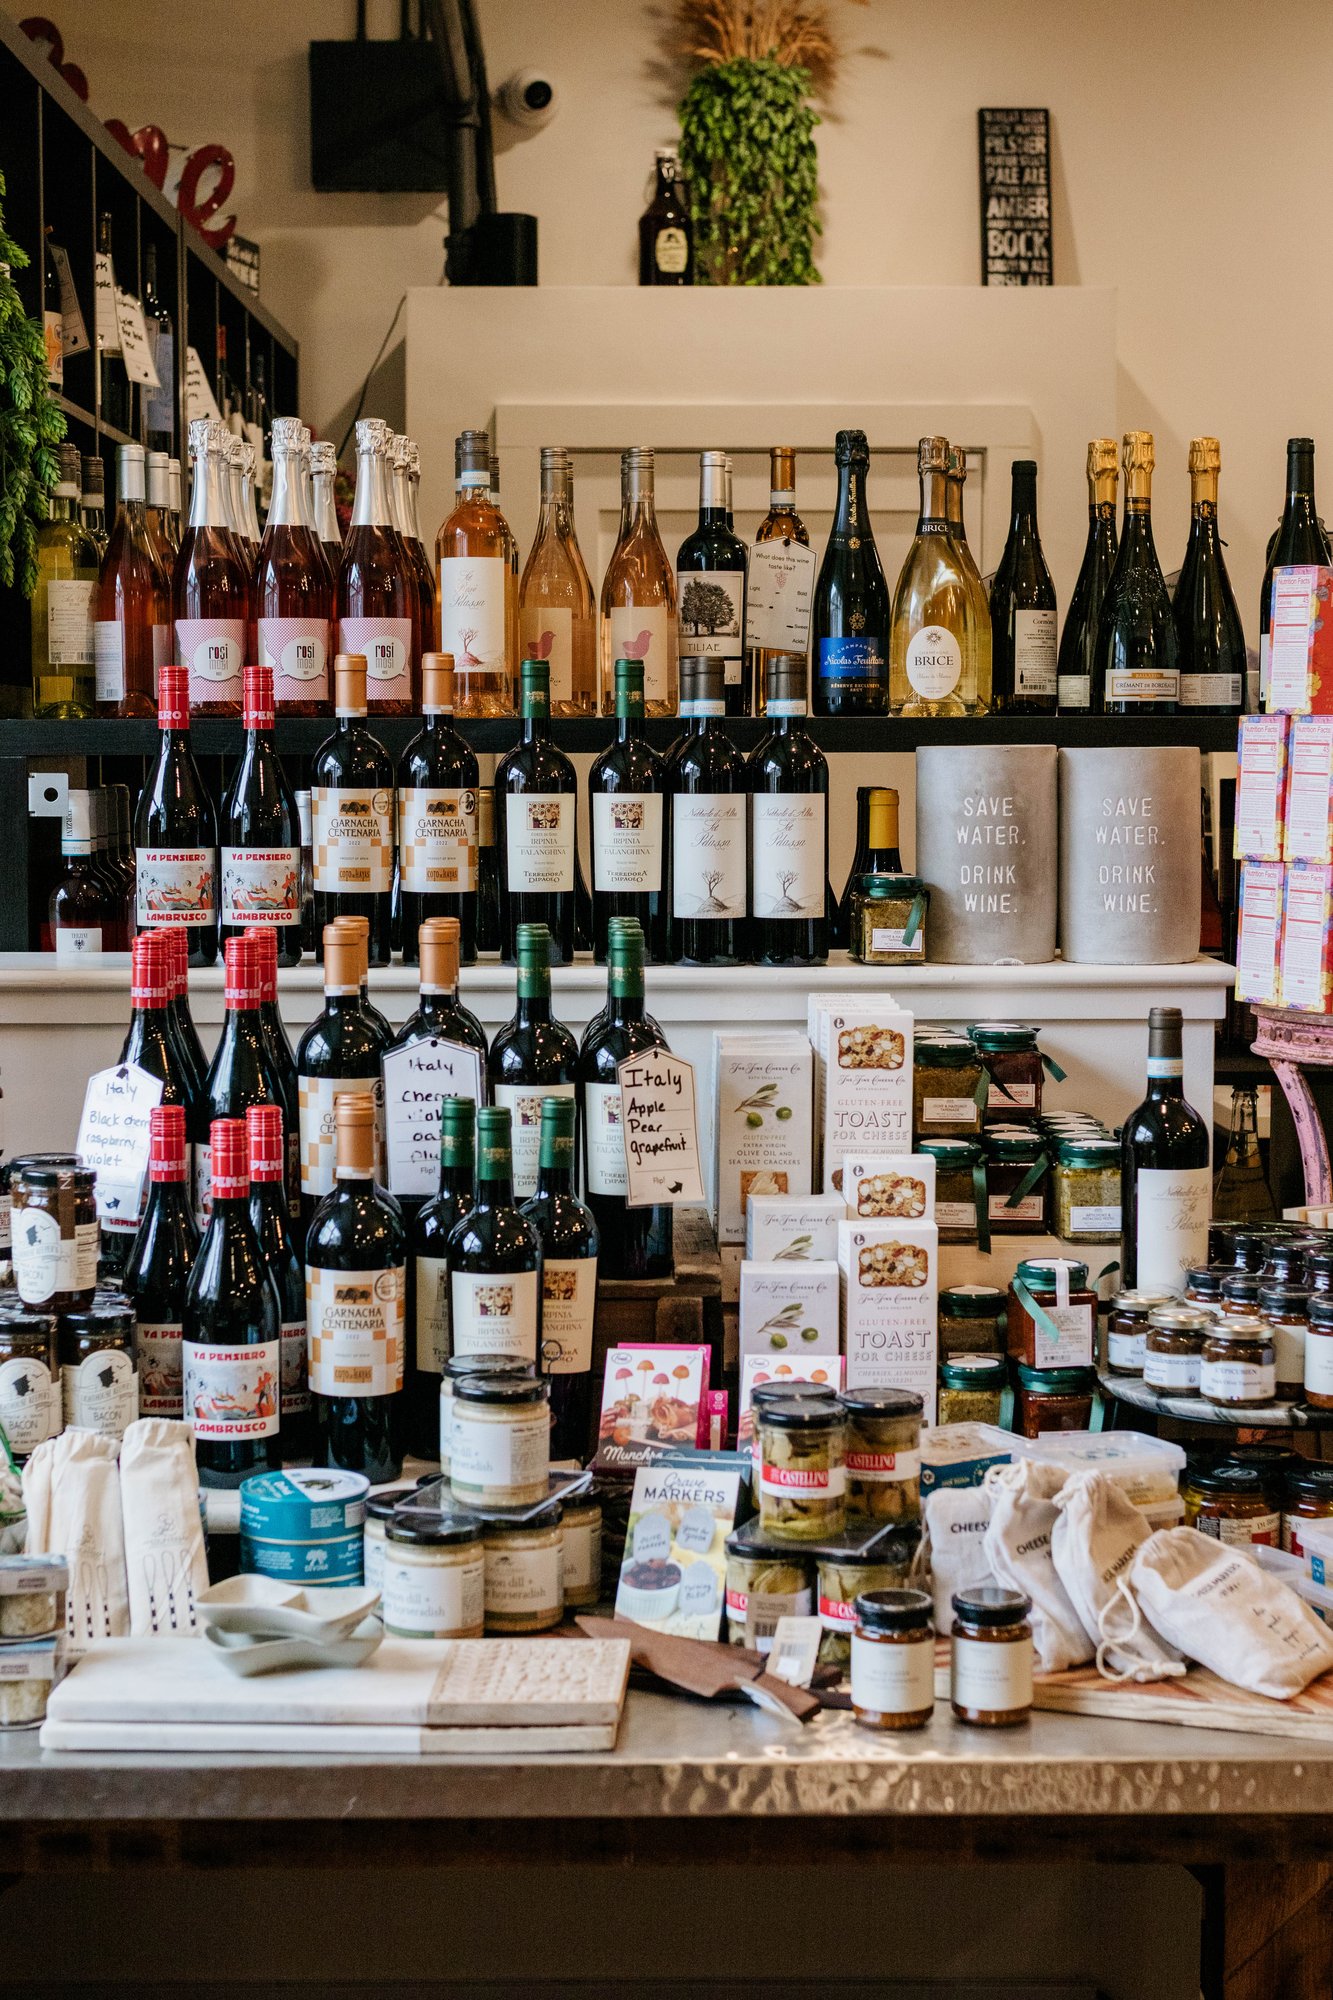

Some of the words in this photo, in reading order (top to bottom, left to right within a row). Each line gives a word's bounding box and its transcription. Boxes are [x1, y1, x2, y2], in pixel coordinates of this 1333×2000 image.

[986, 167, 1020, 185] PALE
[1022, 167, 1047, 185] ALE
[987, 197, 1049, 218] AMBER
[987, 230, 1049, 258] BOCK
[921, 524, 949, 532] BRICE
[296, 642, 315, 658] rosi
[375, 642, 394, 658] rosi
[914, 656, 954, 666] BRICE
[964, 797, 1014, 817] SAVE
[1102, 797, 1152, 817] SAVE
[330, 818, 379, 828] GARNACHA
[418, 818, 465, 828] GARNACHA
[328, 828, 382, 838] CENTENARIA
[415, 828, 468, 838] CENTENARIA
[956, 826, 1026, 845] WATER.
[1096, 826, 1166, 846] WATER.
[146, 854, 157, 862] VA
[160, 854, 206, 862] PENSIERO
[246, 853, 292, 861] PENSIERO
[520, 848, 566, 856] FALANGHINA
[604, 848, 650, 856] FALANGHINA
[523, 870, 564, 878] TERREDORA
[960, 865, 1017, 886] DRINK
[1099, 864, 1156, 886] DRINK
[1246, 870, 1264, 878] Nutrition
[964, 893, 1018, 914] WINE.
[1103, 893, 1158, 914] WINE.
[146, 913, 208, 922] LAMBRUSCO
[232, 912, 292, 920] LAMBRUSCO
[409, 1057, 454, 1076] Italy
[624, 1068, 682, 1094] Italy
[106, 1083, 138, 1102] Italy
[627, 1097, 666, 1118] Apple
[90, 1111, 119, 1126] Black
[124, 1115, 149, 1127] cherr
[834, 1110, 906, 1128] TOAST
[627, 1118, 662, 1134] Pear
[413, 1130, 442, 1142] oa
[833, 1131, 856, 1140] FOR
[862, 1130, 910, 1140] CHEESE
[86, 1134, 136, 1149] raspberry
[630, 1132, 686, 1166] grapefruit
[86, 1154, 122, 1166] violet
[410, 1150, 440, 1164] plu
[420, 1166, 436, 1174] Flip!
[325, 1306, 382, 1318] GARNACHA
[322, 1318, 385, 1330] CENTENARIA
[858, 1318, 927, 1326] GLUTEN-FREE
[144, 1330, 158, 1339] VA
[855, 1330, 931, 1348] TOAST
[466, 1340, 522, 1348] FALANGHINA
[194, 1351, 206, 1360] VA
[209, 1350, 266, 1361] PENSIERO
[854, 1352, 878, 1362] FOR
[884, 1350, 934, 1362] CHEESE
[94, 1410, 122, 1421] BACON
[8, 1420, 38, 1430] BACON
[194, 1422, 266, 1433] LAMBRUSCO
[664, 1472, 706, 1490] Grave
[780, 1469, 828, 1486] CASTELLINO
[644, 1487, 726, 1503] MARKERS
[950, 1521, 990, 1534] CHEES
[1016, 1535, 1050, 1556] CHEESE
[508, 1576, 524, 1587] dill
